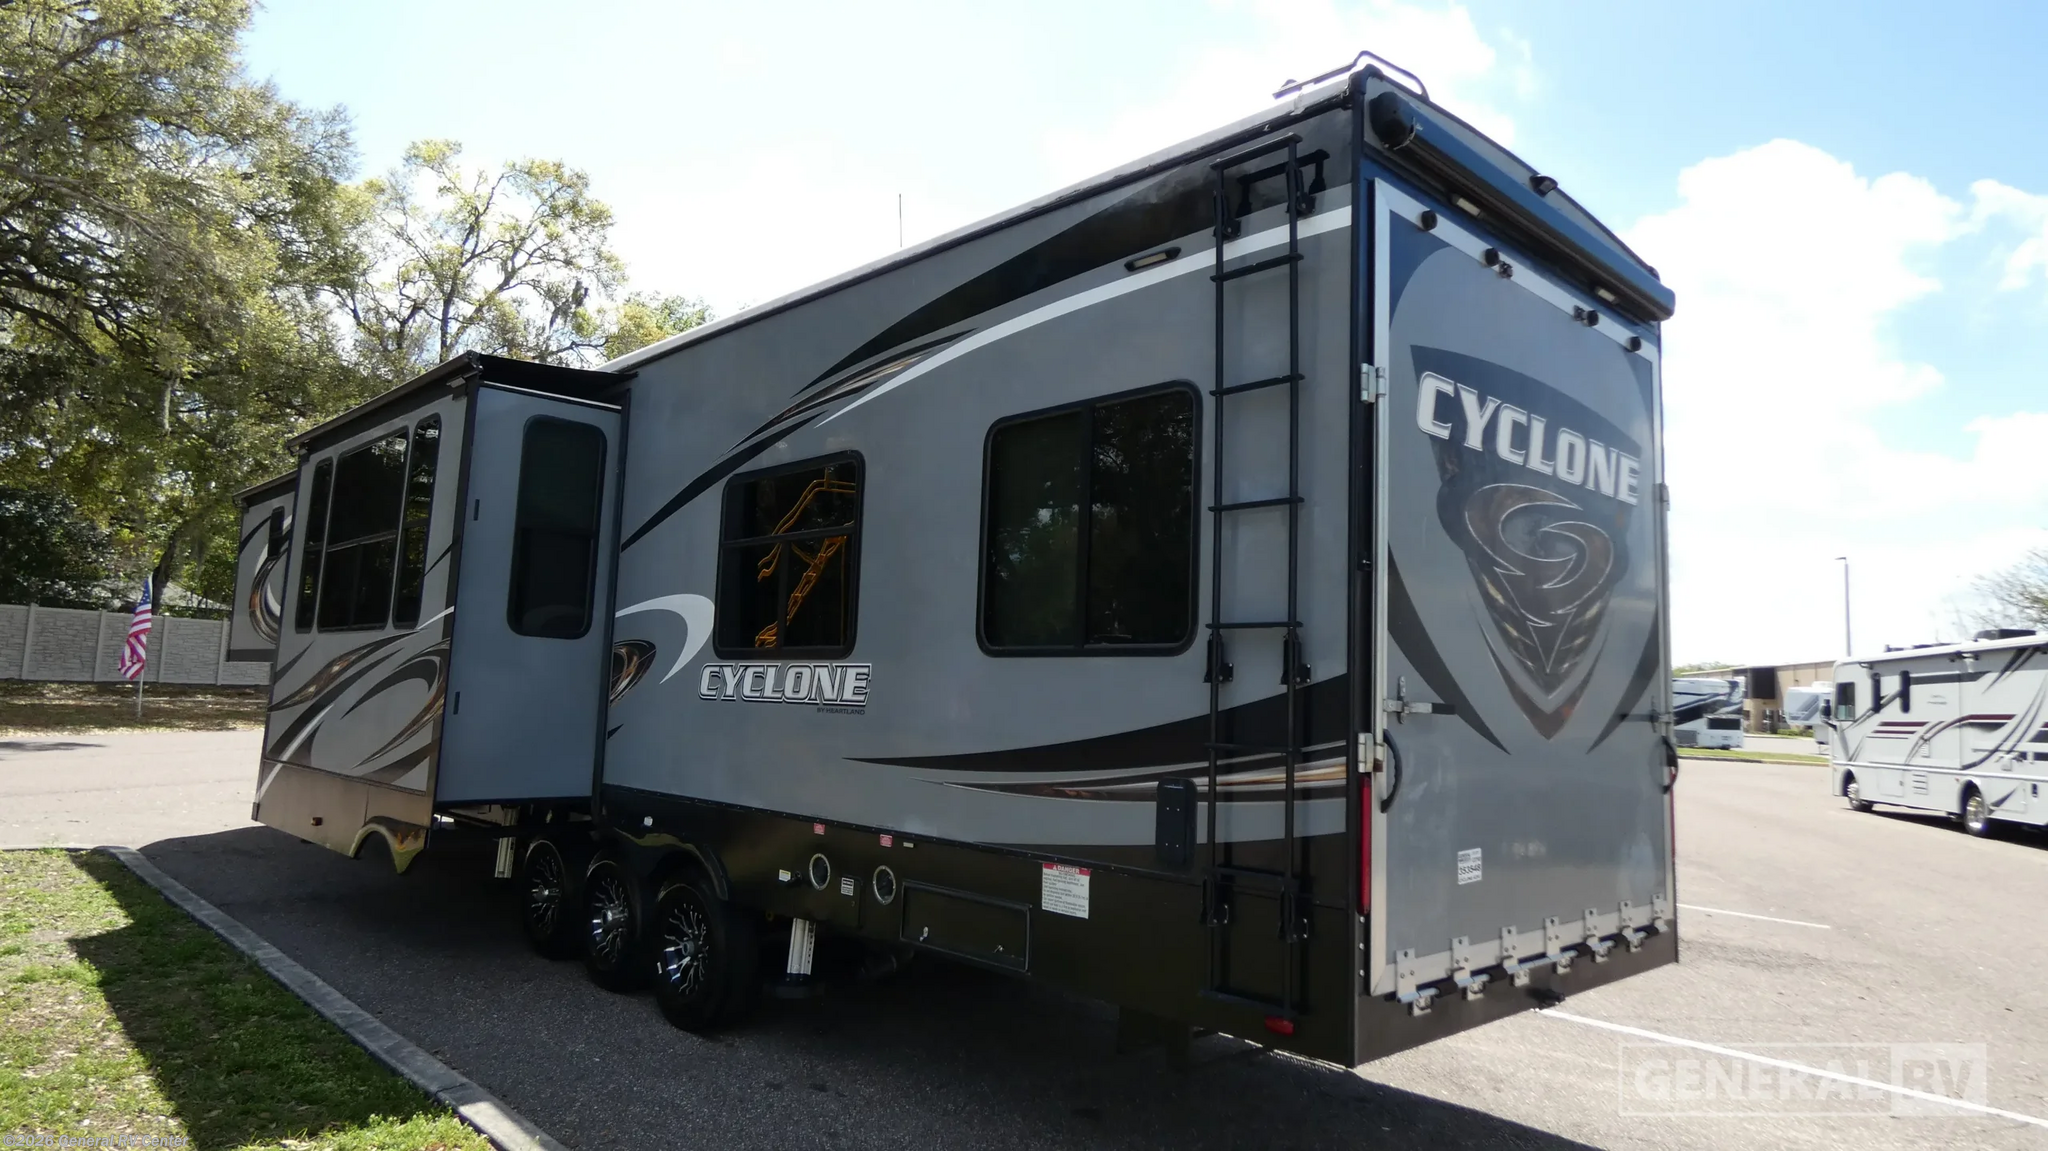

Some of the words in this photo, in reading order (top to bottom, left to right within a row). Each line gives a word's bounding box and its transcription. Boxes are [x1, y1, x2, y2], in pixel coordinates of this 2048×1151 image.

[1416, 371, 1641, 506] CYCLONE
[699, 662, 872, 706] CYCLONE
[826, 707, 866, 715] HEARTLAND
[1057, 865, 1080, 874] DANGER
